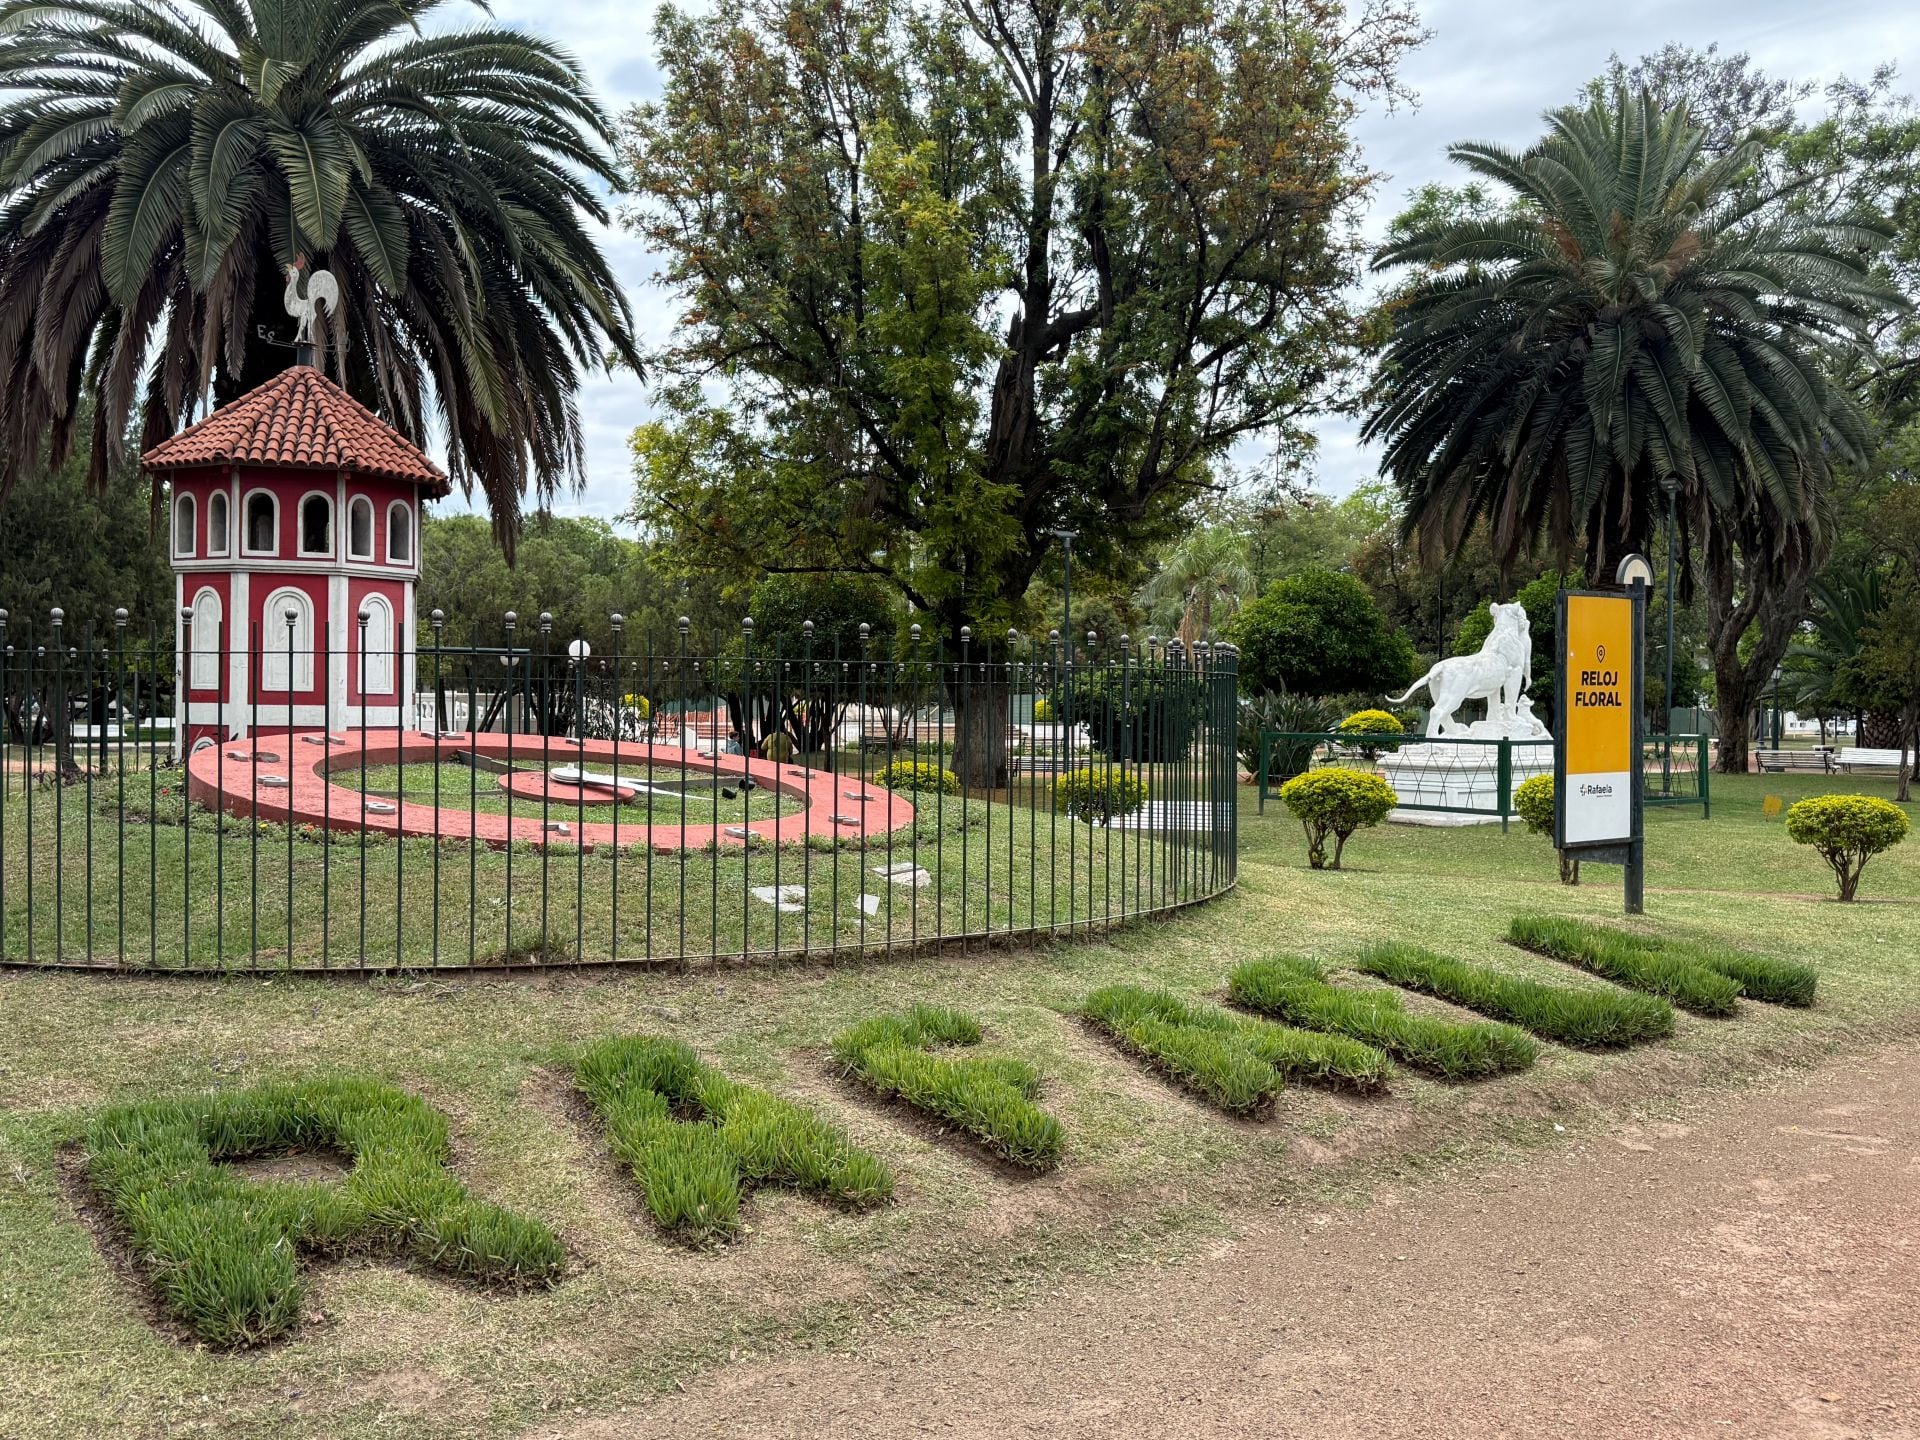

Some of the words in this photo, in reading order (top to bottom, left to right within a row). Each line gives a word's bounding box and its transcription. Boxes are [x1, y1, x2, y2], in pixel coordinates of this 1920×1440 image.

[1581, 671, 1618, 686] RELOJ
[1575, 691, 1622, 707] FLORAL
[1587, 784, 1612, 795] Rafaela
[82, 910, 1817, 1352] RAFAELA
